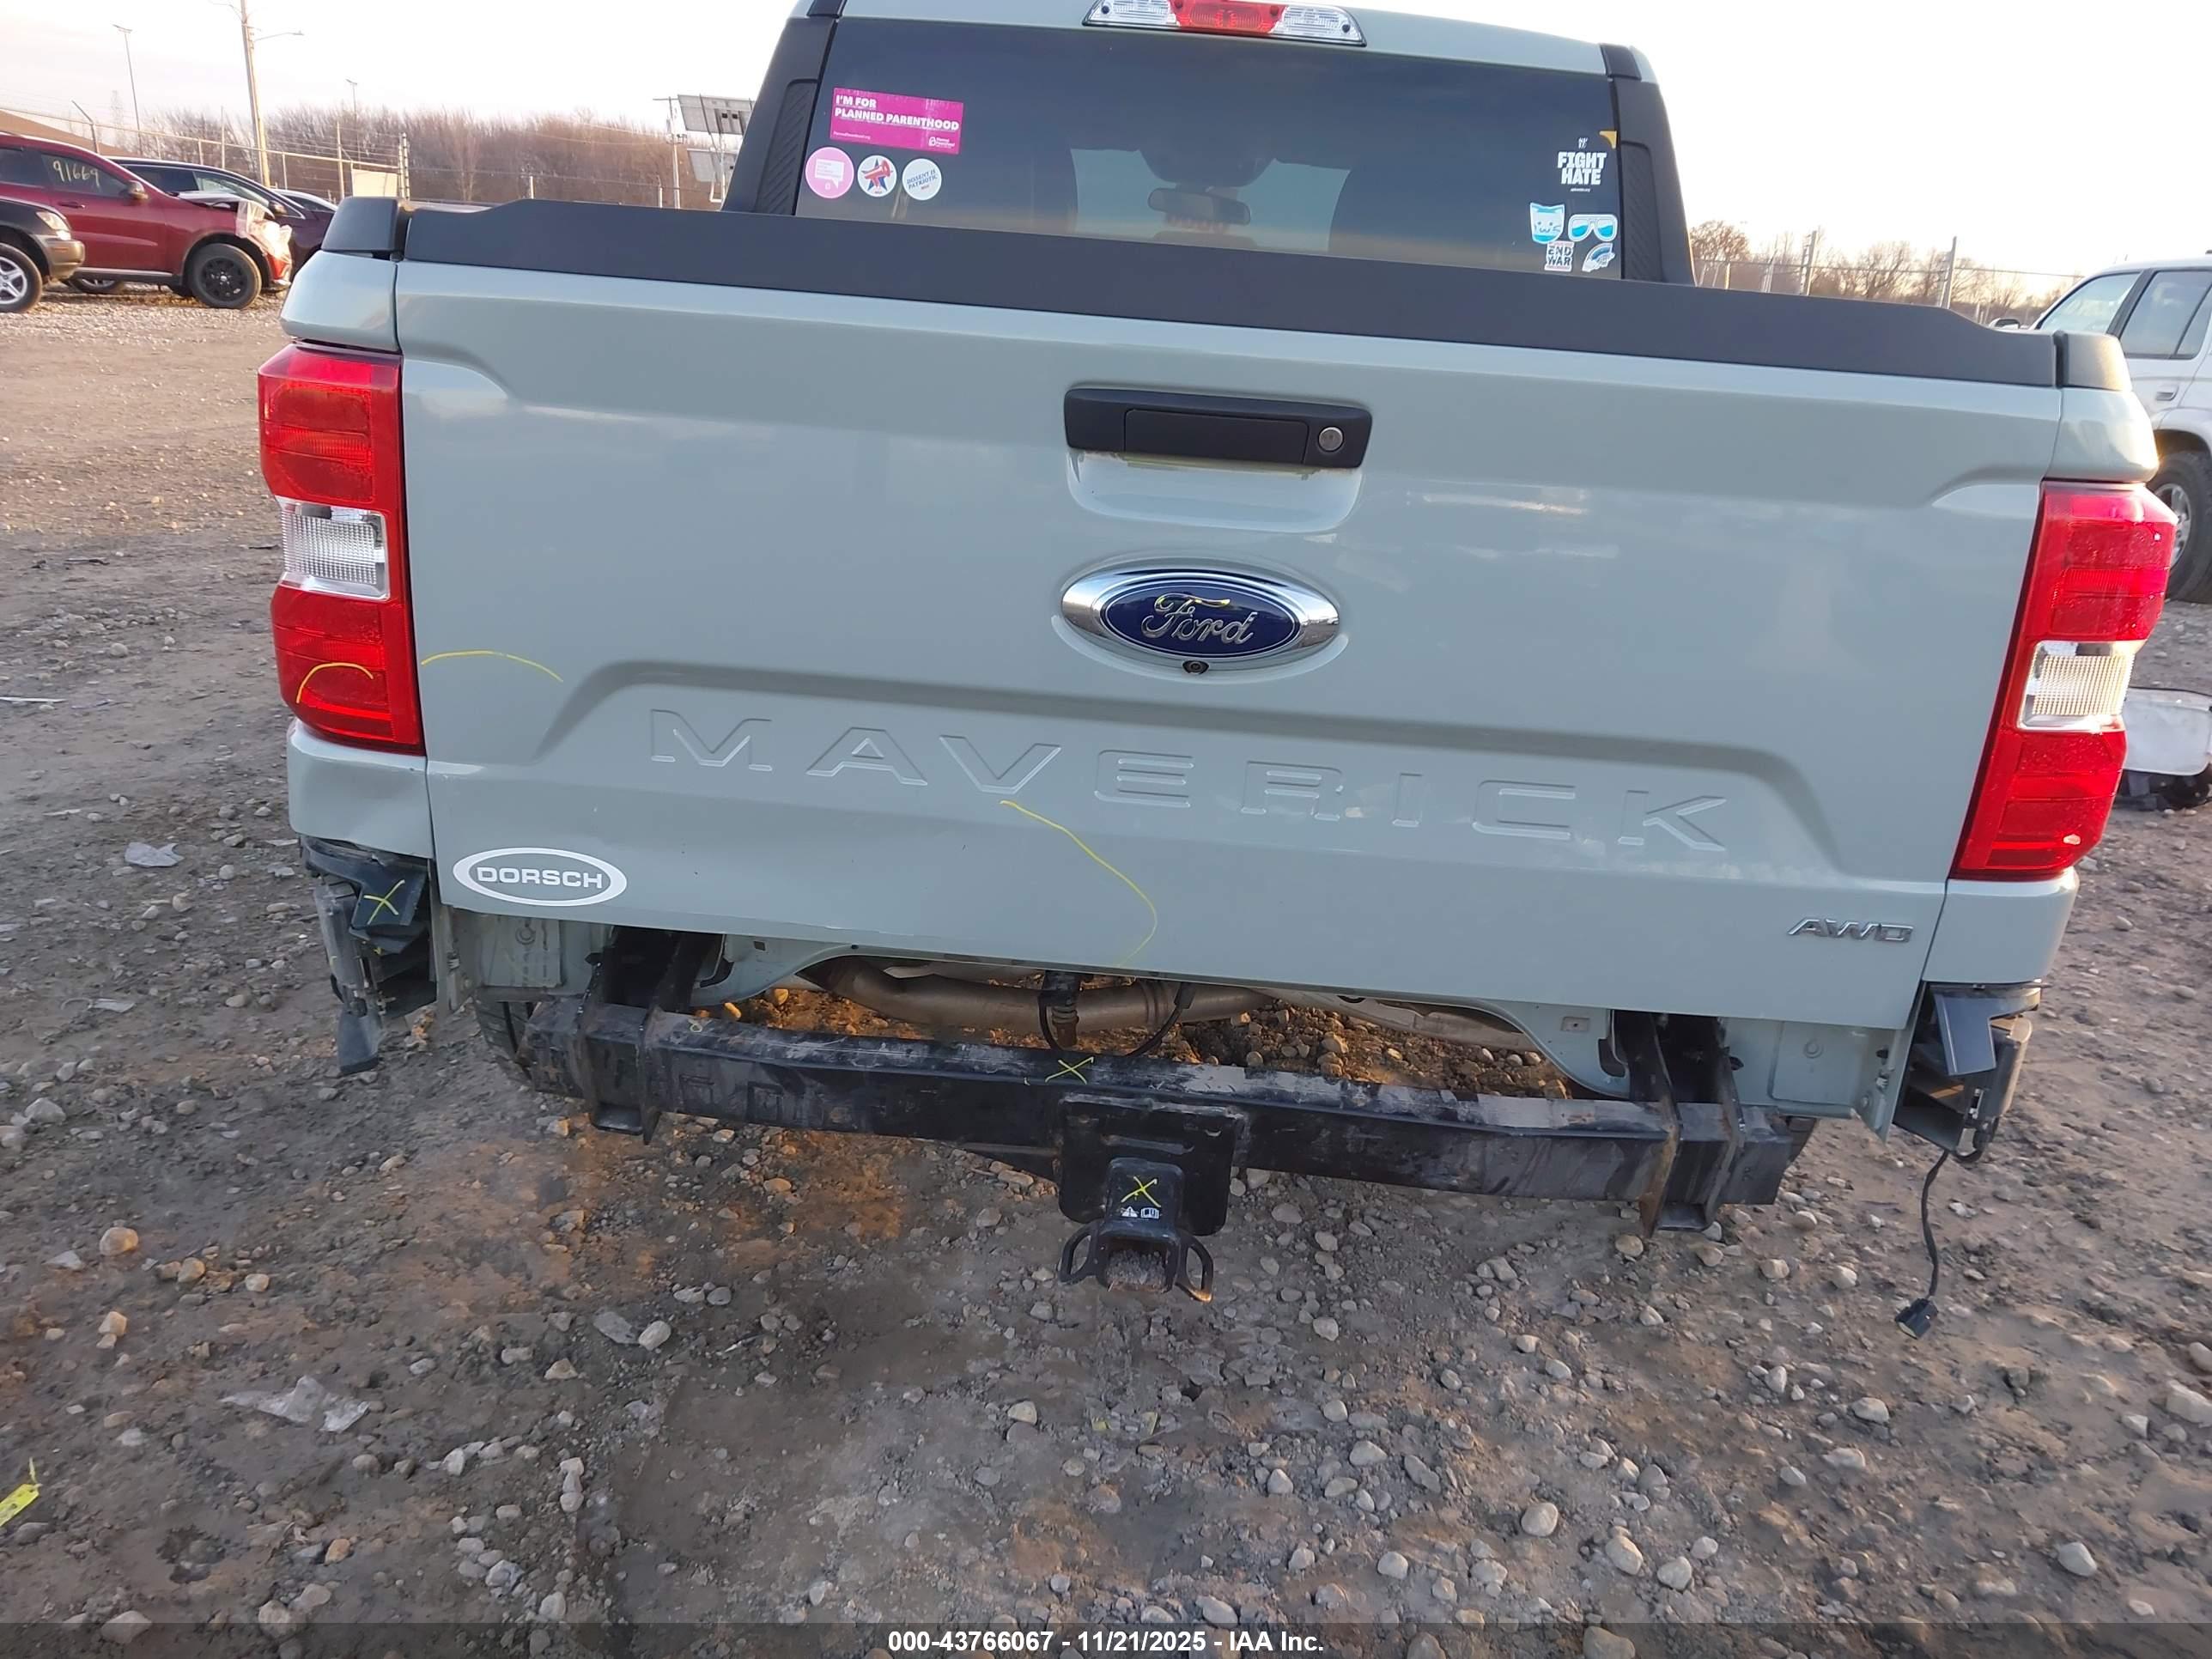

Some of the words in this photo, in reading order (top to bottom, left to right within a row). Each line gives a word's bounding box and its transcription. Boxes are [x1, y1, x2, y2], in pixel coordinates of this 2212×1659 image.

[836, 94, 853, 106] I'M
[854, 96, 877, 108] FOR
[835, 107, 884, 121] PLANNED
[885, 113, 960, 131] PARENTHOOD
[1557, 152, 1607, 168] FIGHT
[53, 161, 100, 187] 91669
[1561, 167, 1601, 185] HATE
[1548, 246, 1571, 256] END
[1141, 592, 1258, 644] Ford
[650, 708, 1727, 853] MAVERICK
[477, 866, 603, 889] DORSCH
[1788, 918, 1915, 943] AWD
